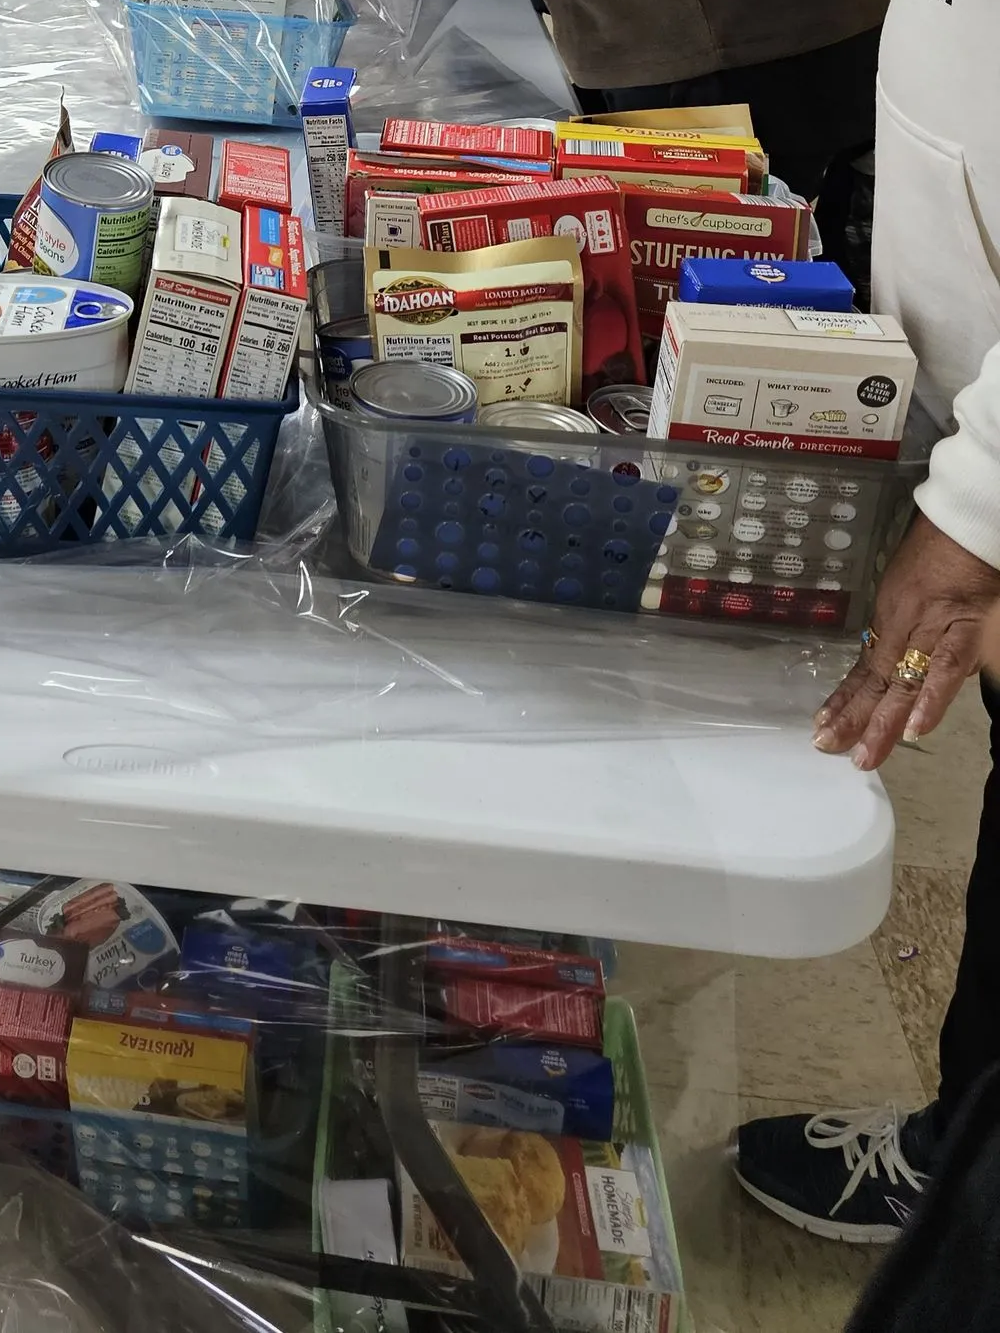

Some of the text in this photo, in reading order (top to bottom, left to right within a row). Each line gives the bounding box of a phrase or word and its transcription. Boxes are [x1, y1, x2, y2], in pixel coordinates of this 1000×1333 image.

[614, 126, 702, 139] KRUSTEAZ
[100, 213, 137, 225] Nutrition
[654, 213, 764, 233] chef's cupboard
[44, 231, 66, 252] Style
[159, 280, 198, 296] Real Simple
[484, 287, 546, 300] LOADED BAKED
[154, 294, 225, 318] Nutrition Facts
[249, 294, 300, 313] Nutrition Facts
[383, 290, 455, 312] IDAHOAN
[749, 302, 786, 310] artificial
[787, 303, 816, 312] flavors,
[799, 316, 868, 326] HOMEMADE
[473, 333, 490, 341] Real
[524, 327, 539, 337] Real
[539, 324, 556, 334] Easy
[145, 330, 217, 354] Calories 100 140
[239, 334, 290, 353] Calories 160 260
[386, 336, 451, 345] Nutrition Facts
[505, 347, 515, 358] 1.
[44, 372, 78, 384] Ham
[706, 378, 746, 387] INCLUDED:
[505, 385, 516, 394] 2.
[767, 383, 833, 394] WHAT YOU NEED:
[864, 385, 891, 397] AS STIR
[870, 380, 890, 391] EASY
[702, 429, 863, 454] Real Simple DIRECTIONS
[20, 952, 57, 969] Turkey
[119, 1032, 195, 1058] KRUSTEAZ
[601, 1175, 625, 1248] HOMEMADE
